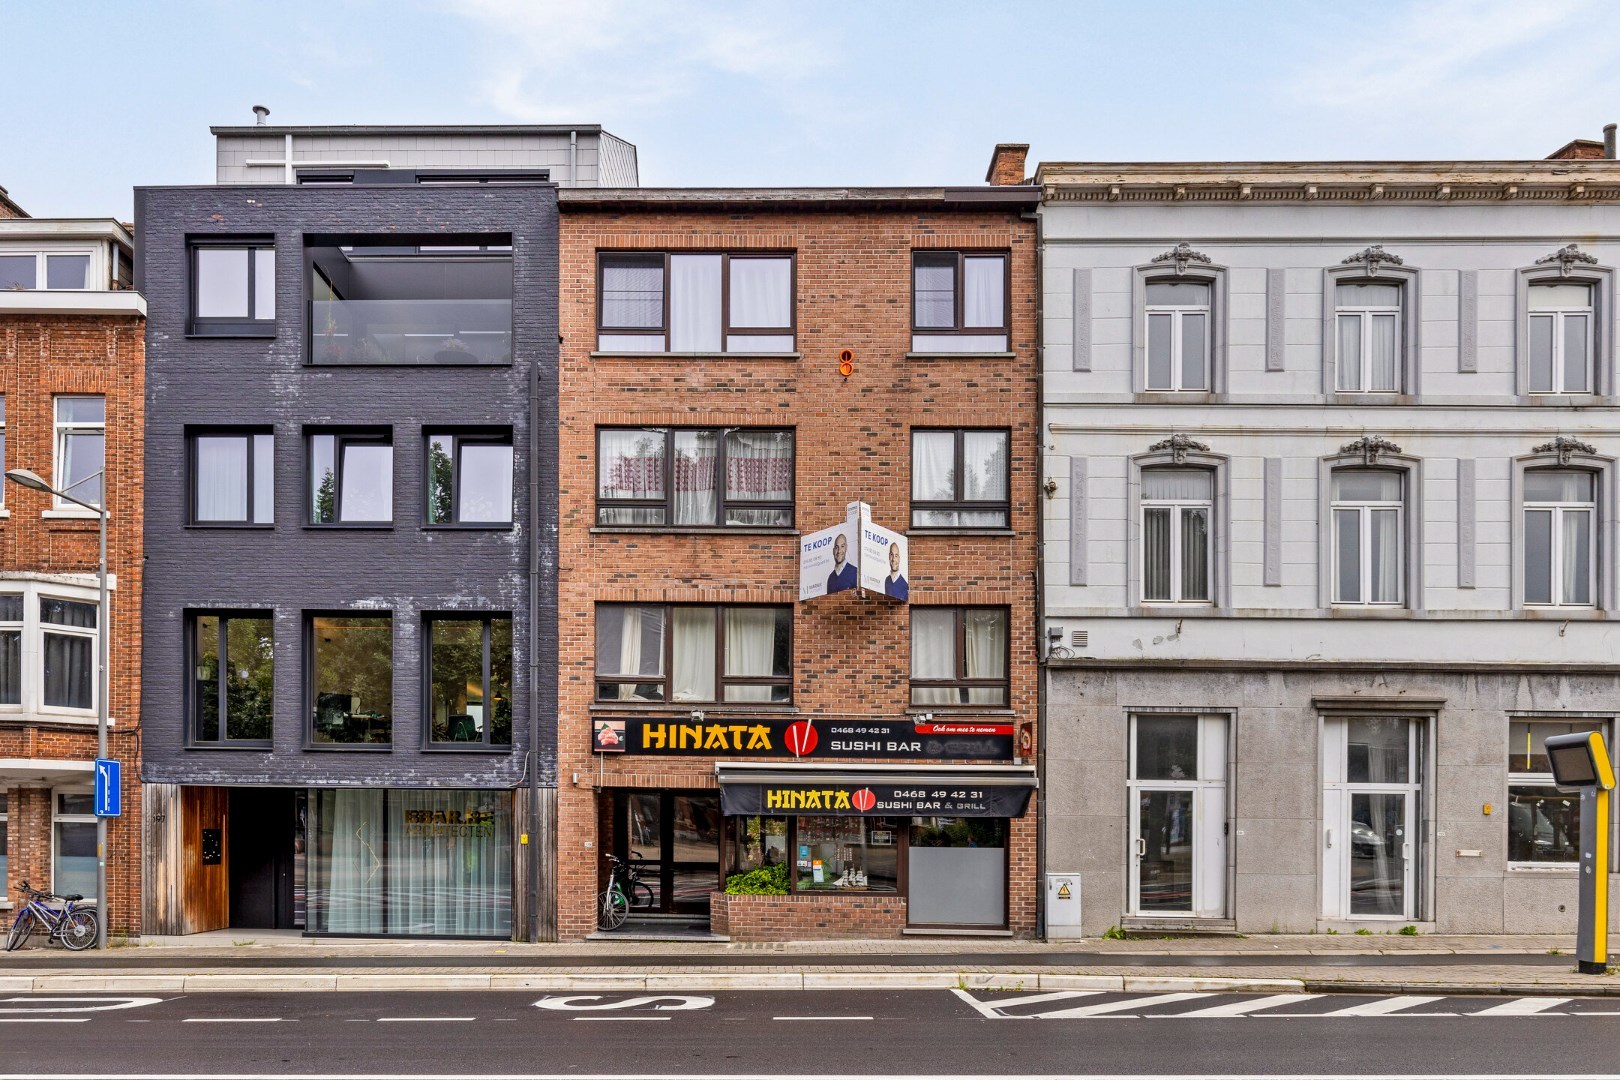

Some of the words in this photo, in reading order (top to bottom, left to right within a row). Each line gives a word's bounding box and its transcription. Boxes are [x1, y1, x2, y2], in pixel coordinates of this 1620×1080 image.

[804, 543, 812, 552] TE
[812, 536, 833, 550] KOOP
[865, 530, 871, 540] TE
[872, 533, 889, 546] KOOP
[643, 723, 773, 750] HINATA
[830, 741, 881, 751] SUSHI
[886, 741, 922, 752] BAR
[767, 789, 851, 810] HINATA
[894, 790, 926, 798] 0468
[950, 791, 967, 799] 42
[970, 791, 983, 799] 31
[877, 801, 912, 809] SUSHI
[916, 801, 941, 809] BAR
[405, 825, 494, 838] ARCHITECTEN
